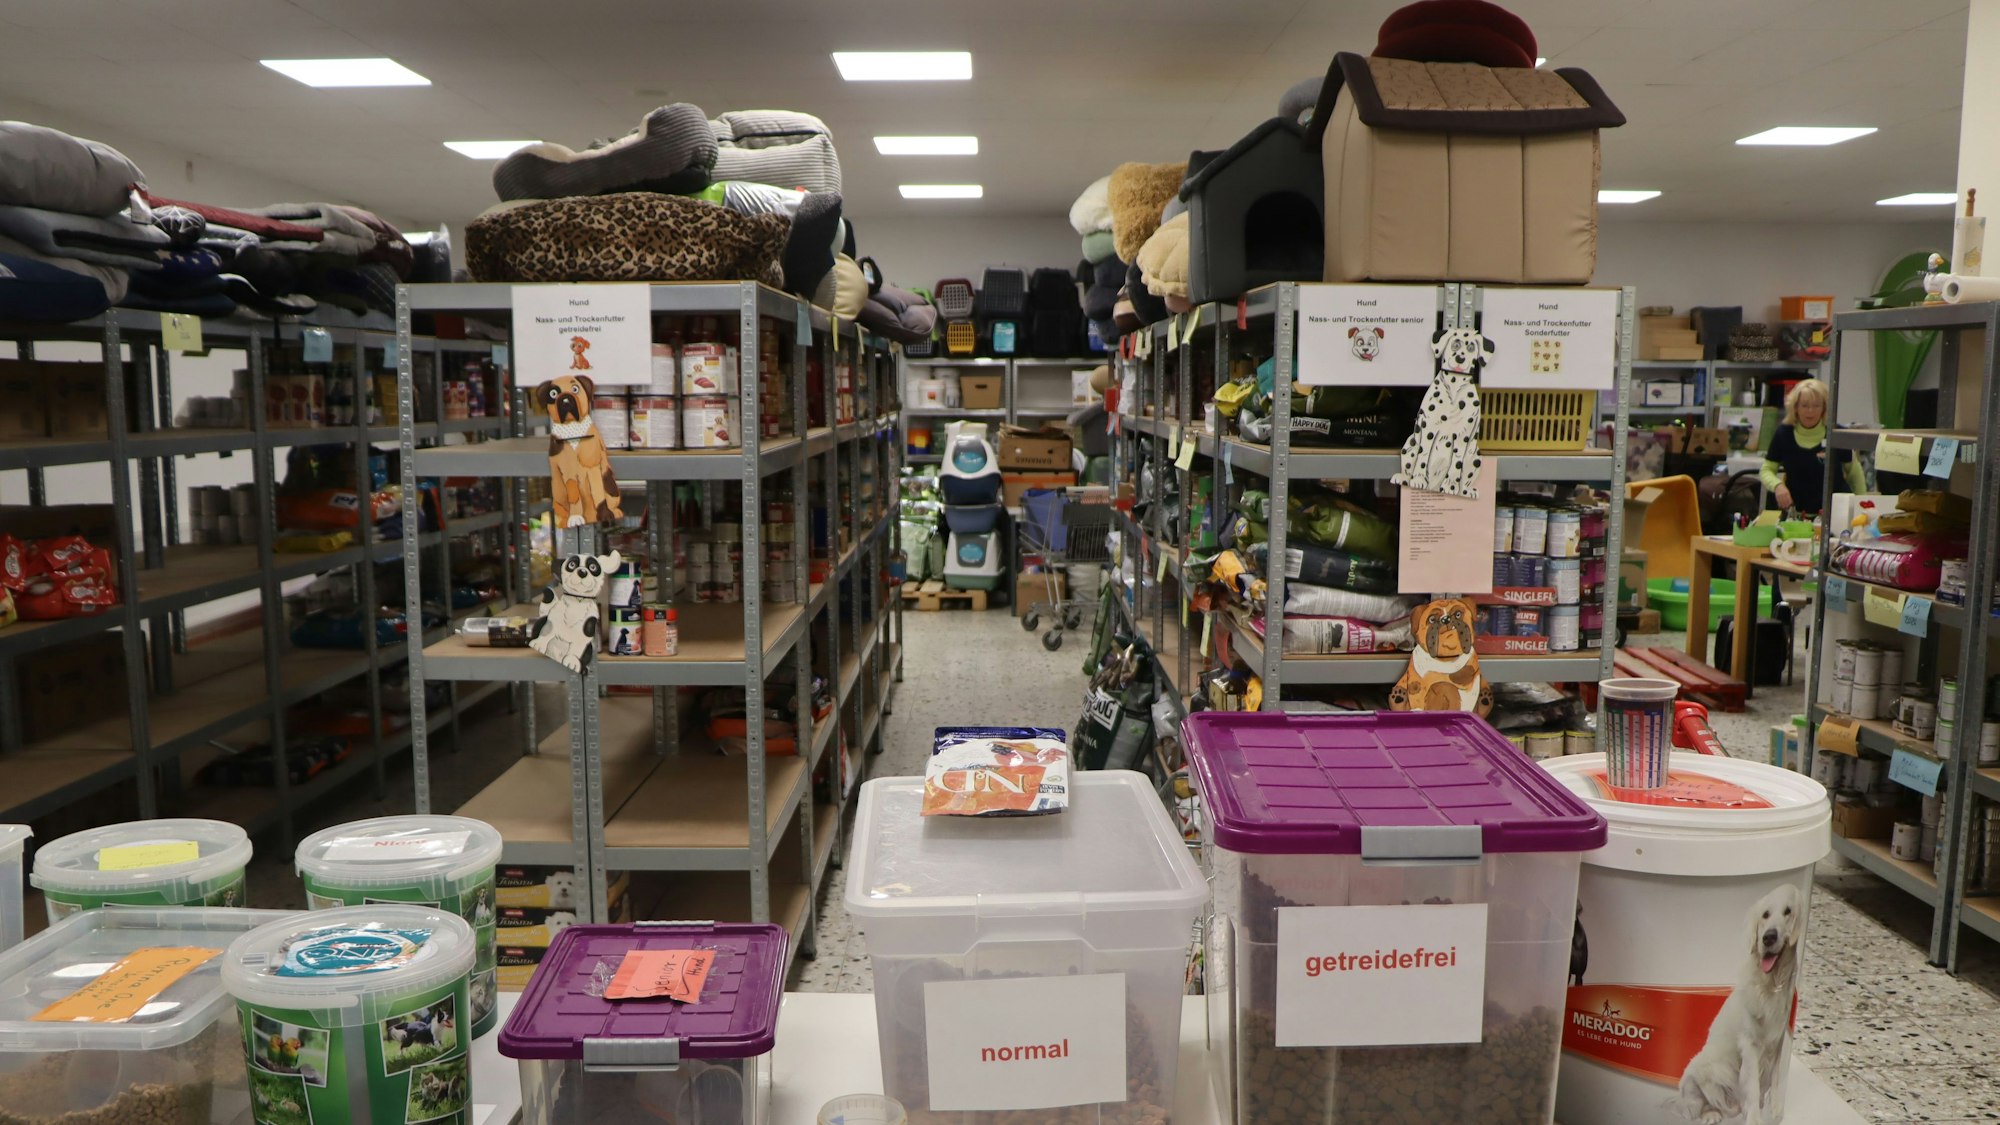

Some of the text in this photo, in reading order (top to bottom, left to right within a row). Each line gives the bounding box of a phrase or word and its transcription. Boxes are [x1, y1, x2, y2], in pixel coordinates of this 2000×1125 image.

[1349, 315, 1398, 323] Trockenfutter
[1542, 319, 1592, 327] Trockenfutter
[558, 325, 602, 334] getreidefrei
[1524, 328, 1571, 336] Sonderfutter
[1292, 417, 1330, 430] HAPPY DOG
[1343, 428, 1378, 437] MONTANA
[1305, 946, 1456, 977] getreidefrei
[1572, 1011, 1651, 1041] MERADOG
[1577, 1029, 1642, 1049] ES LEBE DER HUND
[981, 1038, 1068, 1062] normal
